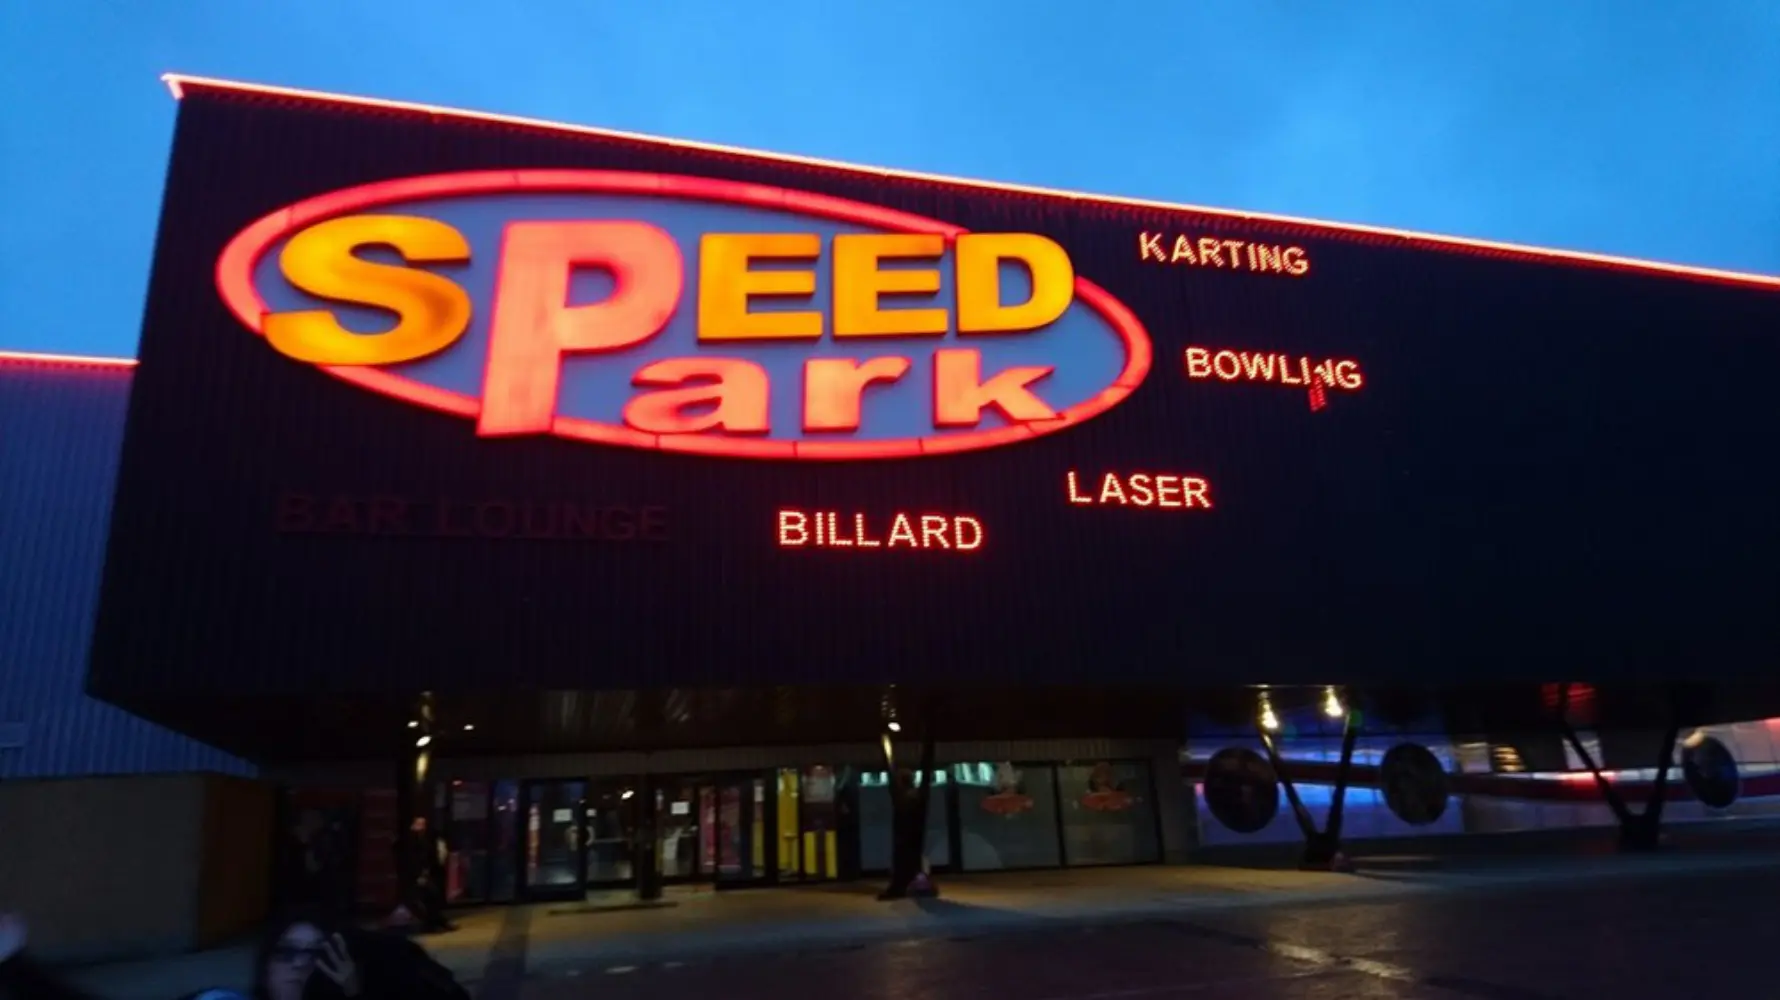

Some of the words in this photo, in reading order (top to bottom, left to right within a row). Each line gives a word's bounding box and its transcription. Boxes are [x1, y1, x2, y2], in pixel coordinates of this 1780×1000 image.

[1138, 231, 1310, 276] KARTING
[1185, 347, 1362, 390] BOWLING
[1067, 471, 1212, 508] LASER
[278, 492, 408, 535] BAR
[438, 498, 671, 542] LOUNGE
[778, 510, 984, 550] BILLARD
